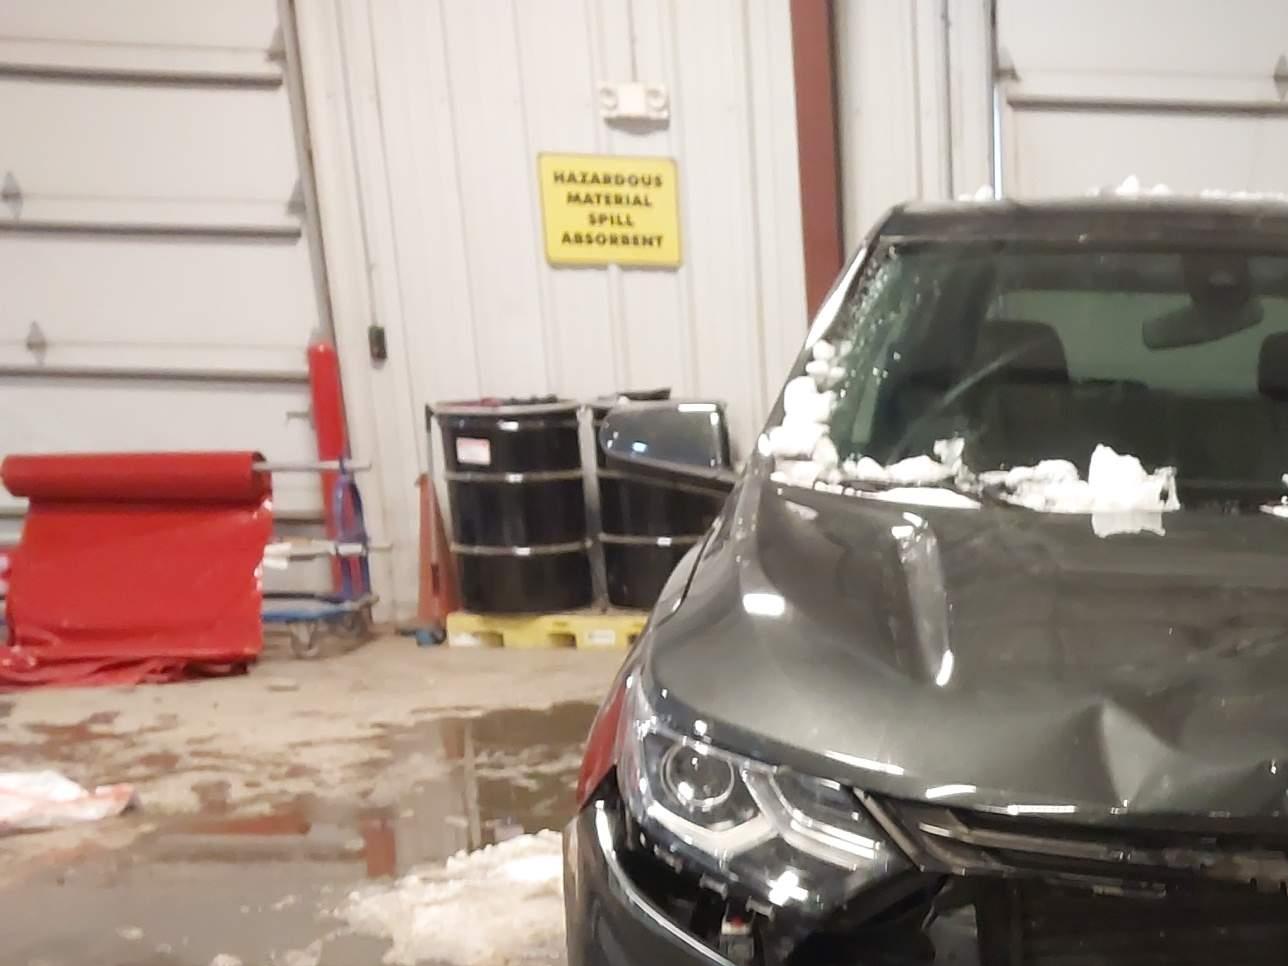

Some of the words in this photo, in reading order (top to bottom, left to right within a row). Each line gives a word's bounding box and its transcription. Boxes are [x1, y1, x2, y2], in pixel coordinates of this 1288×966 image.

[554, 171, 662, 187] HAZARDOUS
[567, 192, 652, 206] MATERIAL
[589, 213, 634, 226] SPILL
[561, 232, 663, 246] ABSORBENT
